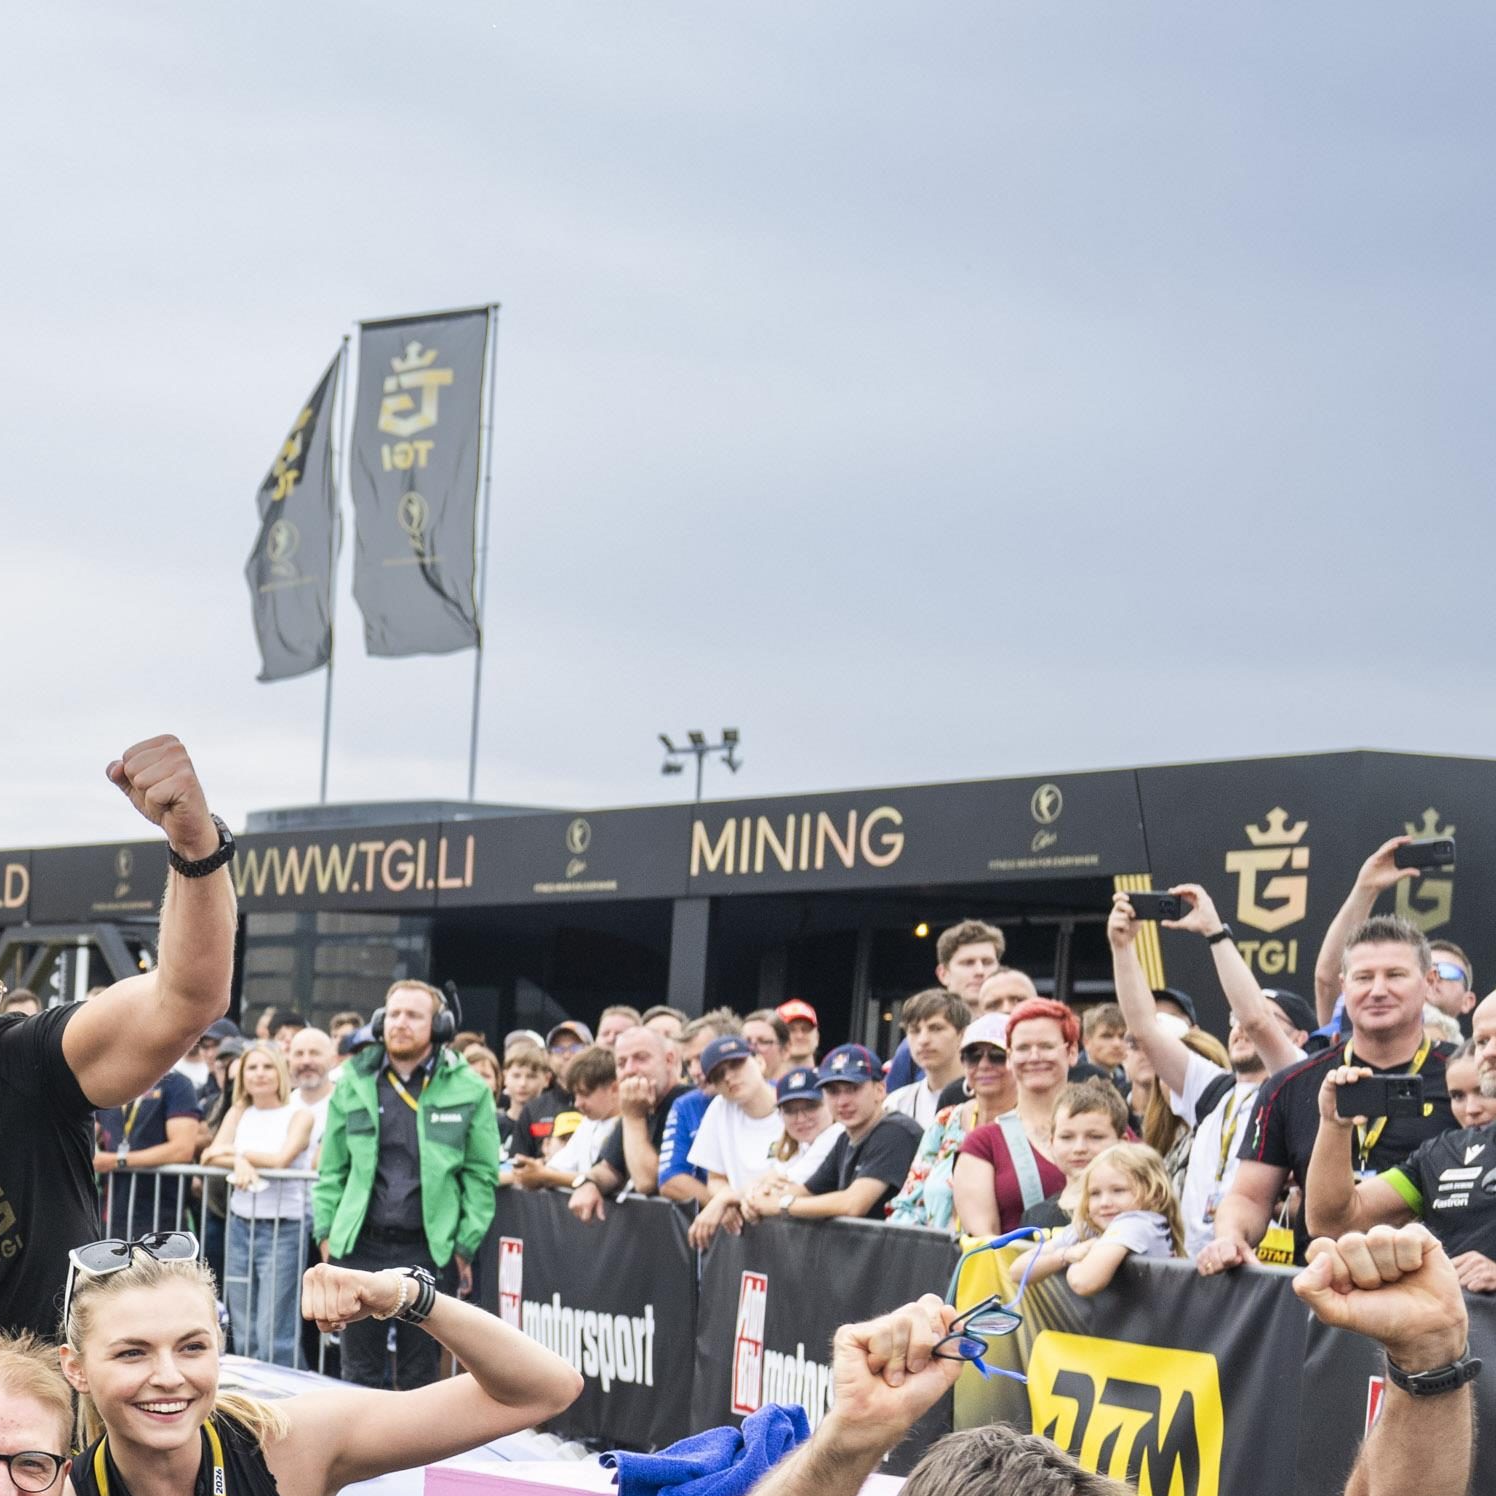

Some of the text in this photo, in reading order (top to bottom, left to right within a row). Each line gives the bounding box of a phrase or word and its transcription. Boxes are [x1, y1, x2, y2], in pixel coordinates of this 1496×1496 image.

[232, 834, 475, 897] WWW.TGI.LI
[690, 806, 905, 877] MINING
[1239, 940, 1298, 975] TGI
[522, 1292, 655, 1393] motorsport
[213, 1466, 225, 1496] 2026
